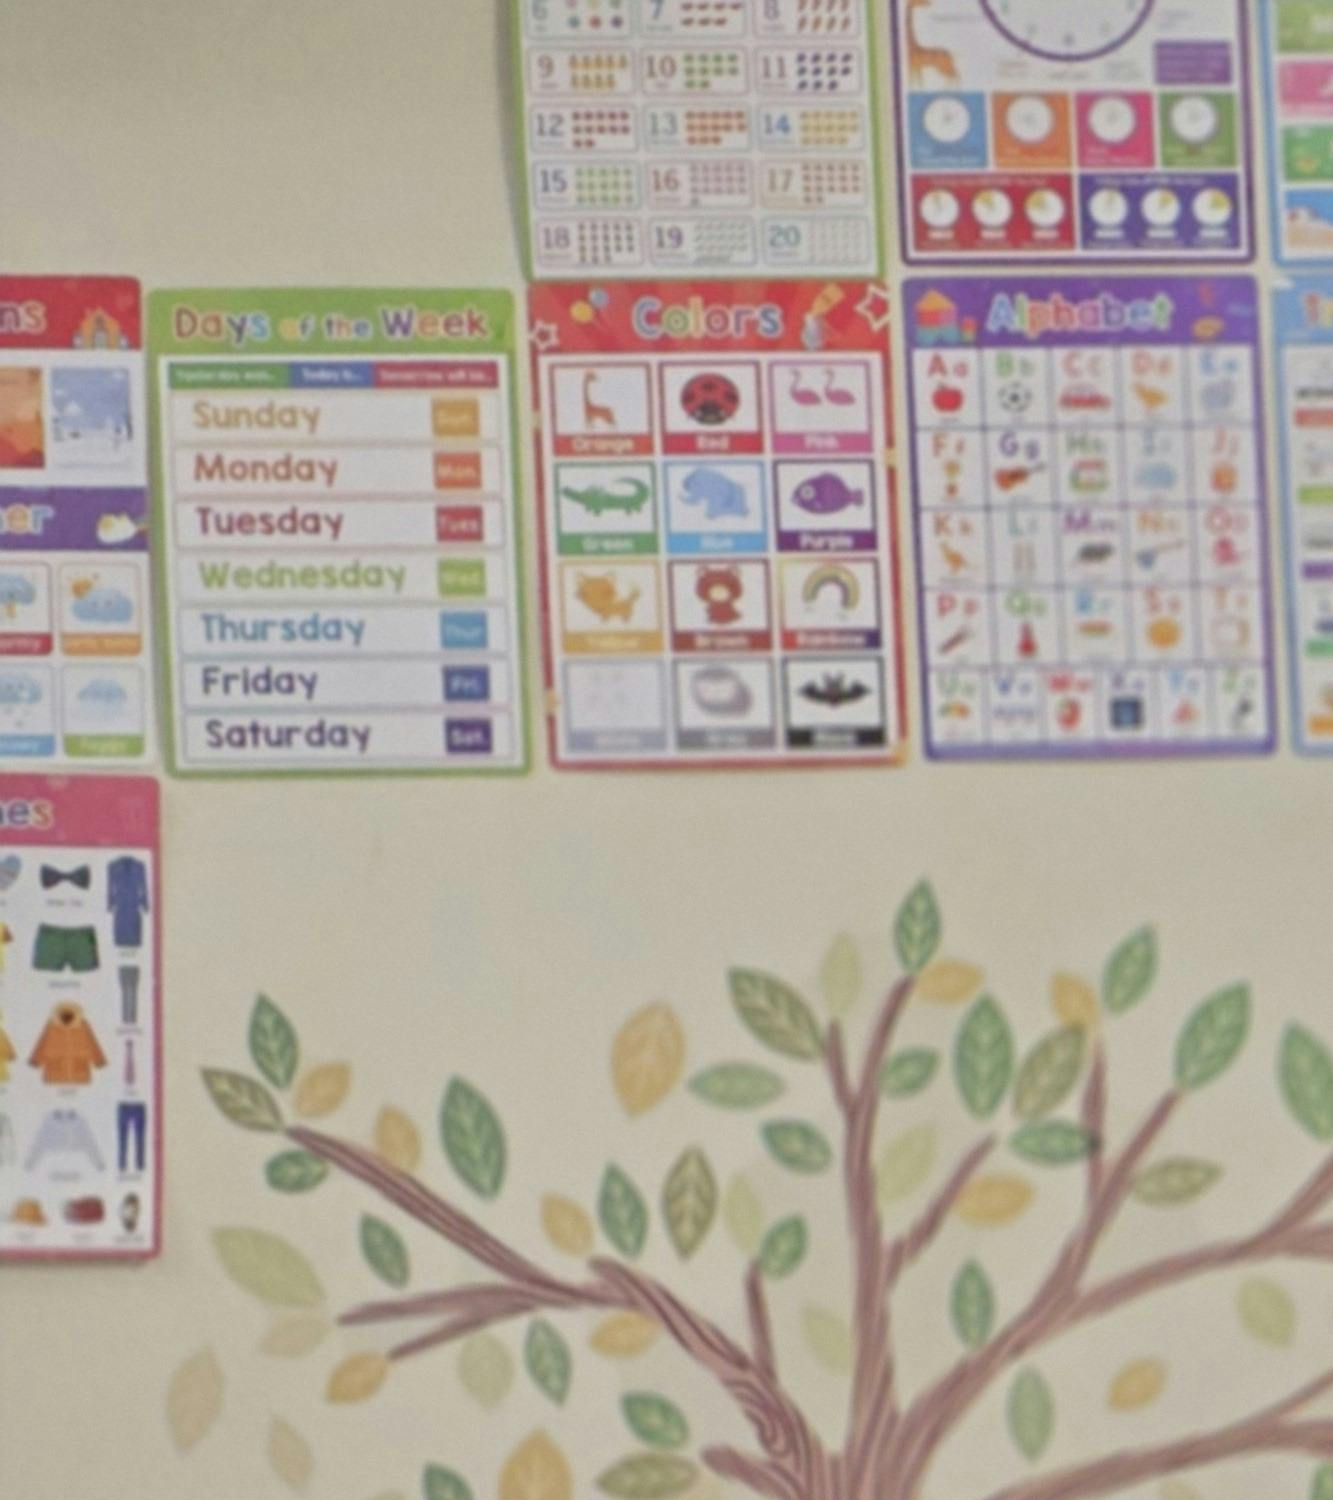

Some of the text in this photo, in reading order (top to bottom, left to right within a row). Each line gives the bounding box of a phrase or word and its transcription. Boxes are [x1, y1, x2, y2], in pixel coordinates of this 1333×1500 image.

[537, 55, 554, 79] 9
[646, 55, 677, 79] 10
[761, 56, 787, 79] 11
[536, 112, 565, 138] 12
[650, 111, 678, 136] 13
[764, 113, 791, 136] 14
[540, 169, 568, 193] 15
[651, 168, 681, 193] 16
[768, 168, 794, 193] 17
[542, 226, 570, 250] 18
[655, 226, 683, 250] 19
[768, 224, 800, 248] 20
[174, 306, 487, 345] Days of the Week
[633, 296, 783, 338] Colors
[987, 292, 1174, 340] Alphabet
[928, 354, 947, 378] A
[193, 400, 322, 433] Sunday
[571, 435, 634, 452] Orange
[697, 434, 730, 449] Red
[999, 432, 1019, 457] G
[193, 453, 338, 486] Monday
[197, 507, 344, 541] Tuesday
[582, 536, 635, 551] Green
[799, 533, 854, 552] Purple
[199, 560, 407, 593] Wednesday
[201, 612, 365, 646] Thursday
[695, 633, 748, 648] Brown
[201, 667, 318, 700] Friday
[205, 720, 371, 754] Saturday
